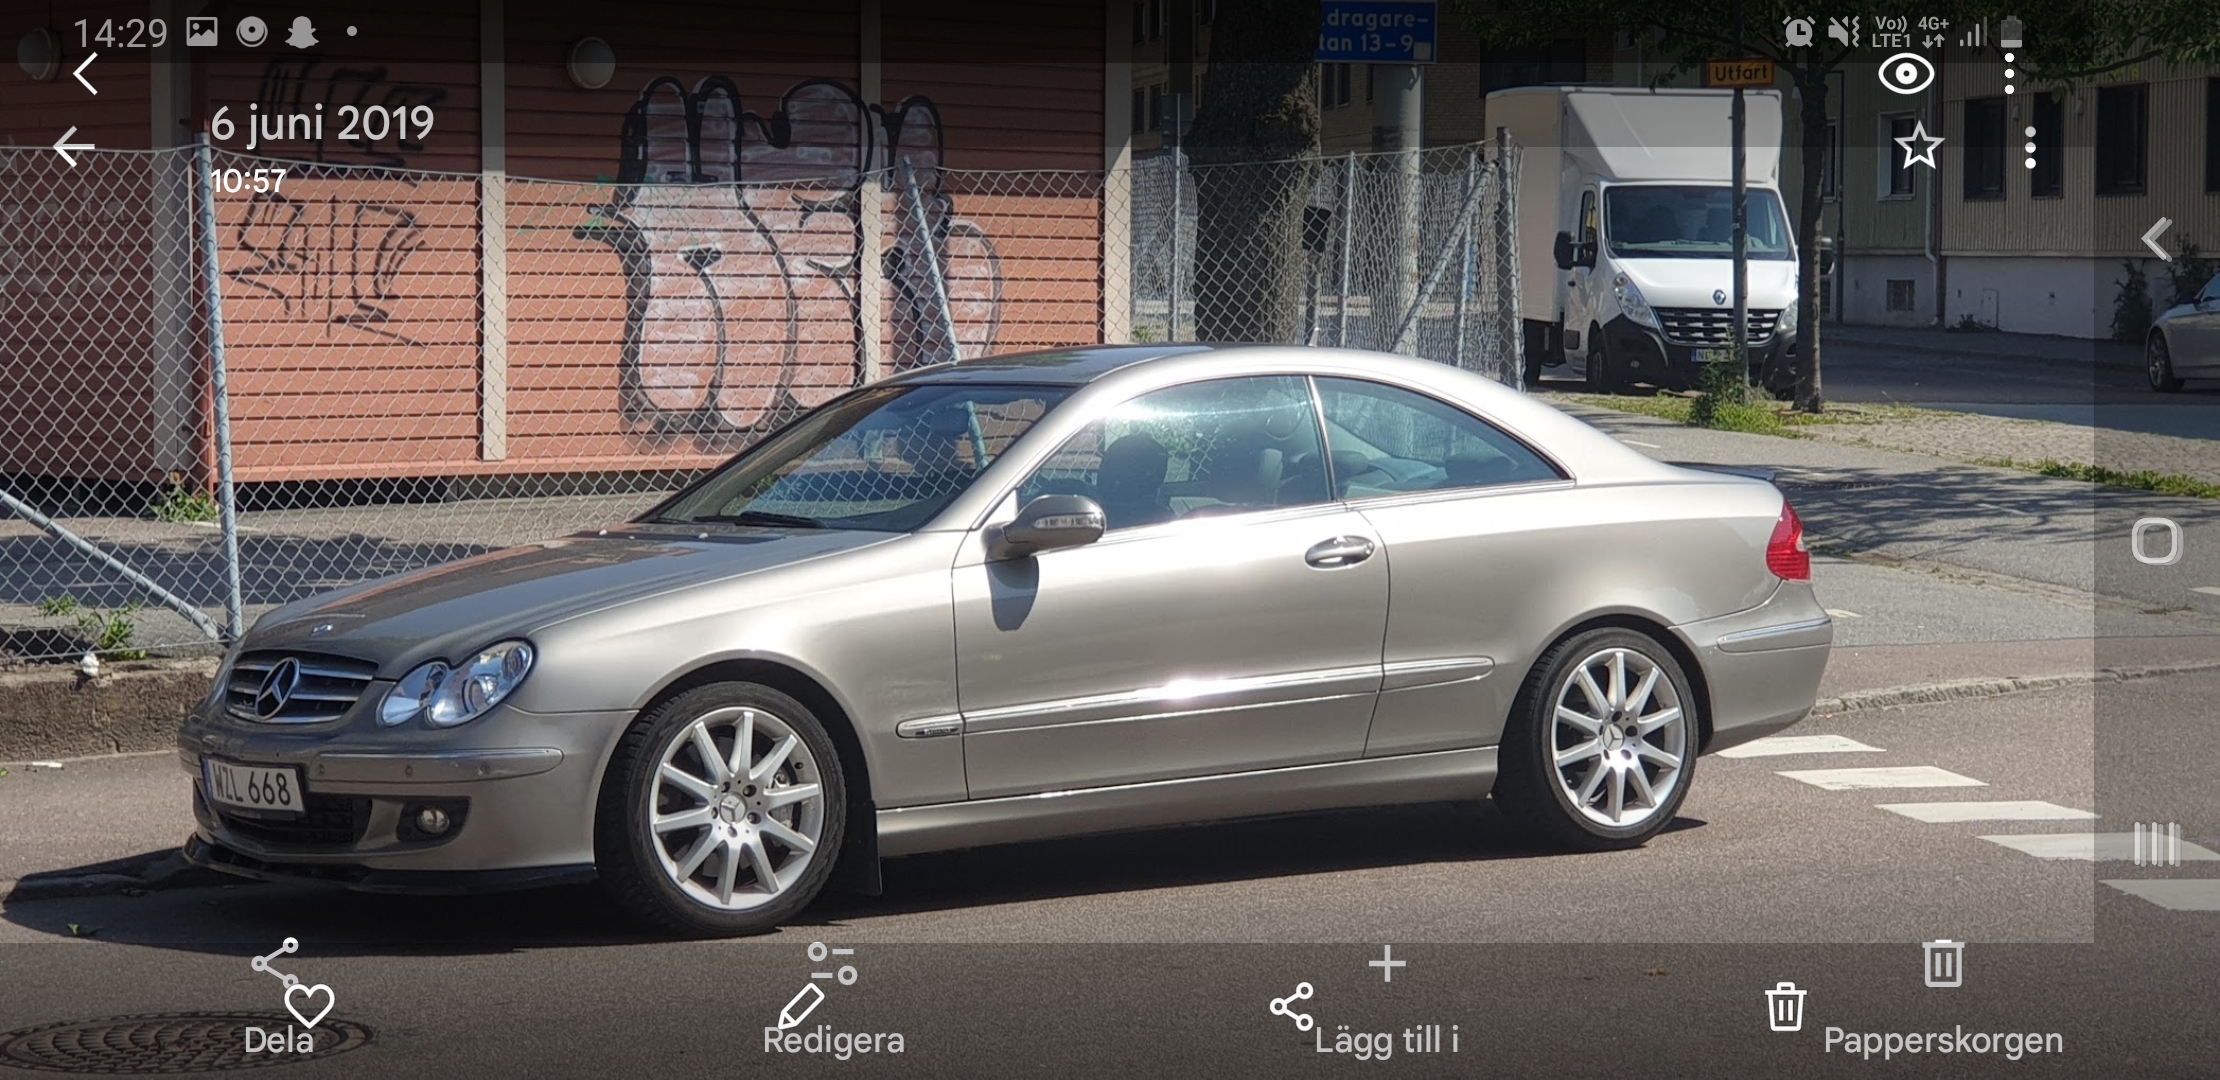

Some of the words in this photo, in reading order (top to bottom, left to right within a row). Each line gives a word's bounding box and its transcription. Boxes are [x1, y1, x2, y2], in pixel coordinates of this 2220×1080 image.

[1322, 8, 1428, 31] dragare-
[1714, 64, 1767, 81] Utfart
[248, 770, 291, 806] 668
